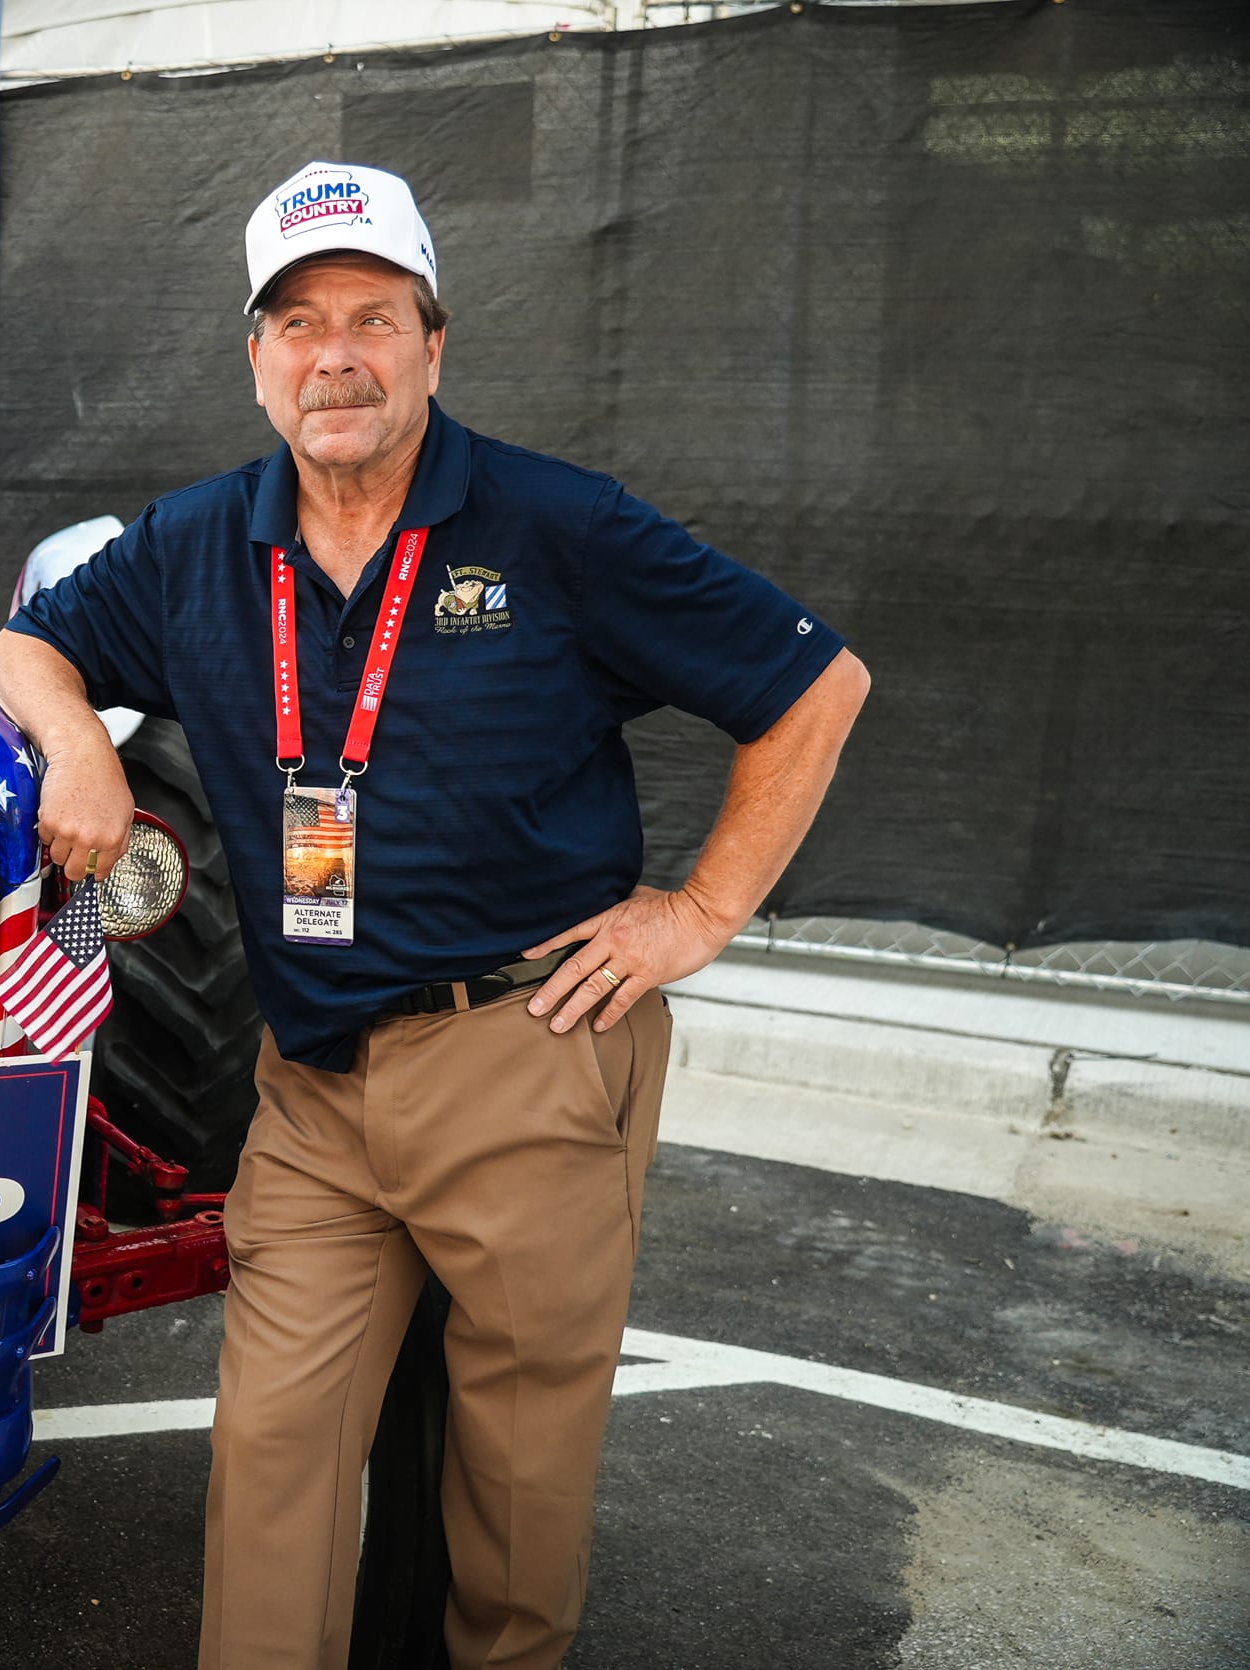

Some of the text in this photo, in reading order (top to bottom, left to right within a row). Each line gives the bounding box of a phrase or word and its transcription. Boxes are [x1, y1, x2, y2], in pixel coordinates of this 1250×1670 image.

[280, 183, 361, 214] TRUMP
[281, 201, 359, 228] COUNTRY
[359, 217, 372, 225] IA
[398, 533, 419, 580] RNC2024
[277, 598, 287, 645] RNC2024
[435, 611, 510, 627] 3RD INFANTRY DIVISION
[363, 672, 376, 697] DATA
[370, 666, 385, 697] TRUST
[336, 805, 348, 820] 3
[286, 896, 320, 905] WEDNESDAY
[294, 908, 342, 919] ALTERNATE
[296, 917, 339, 927] DELEGATE
